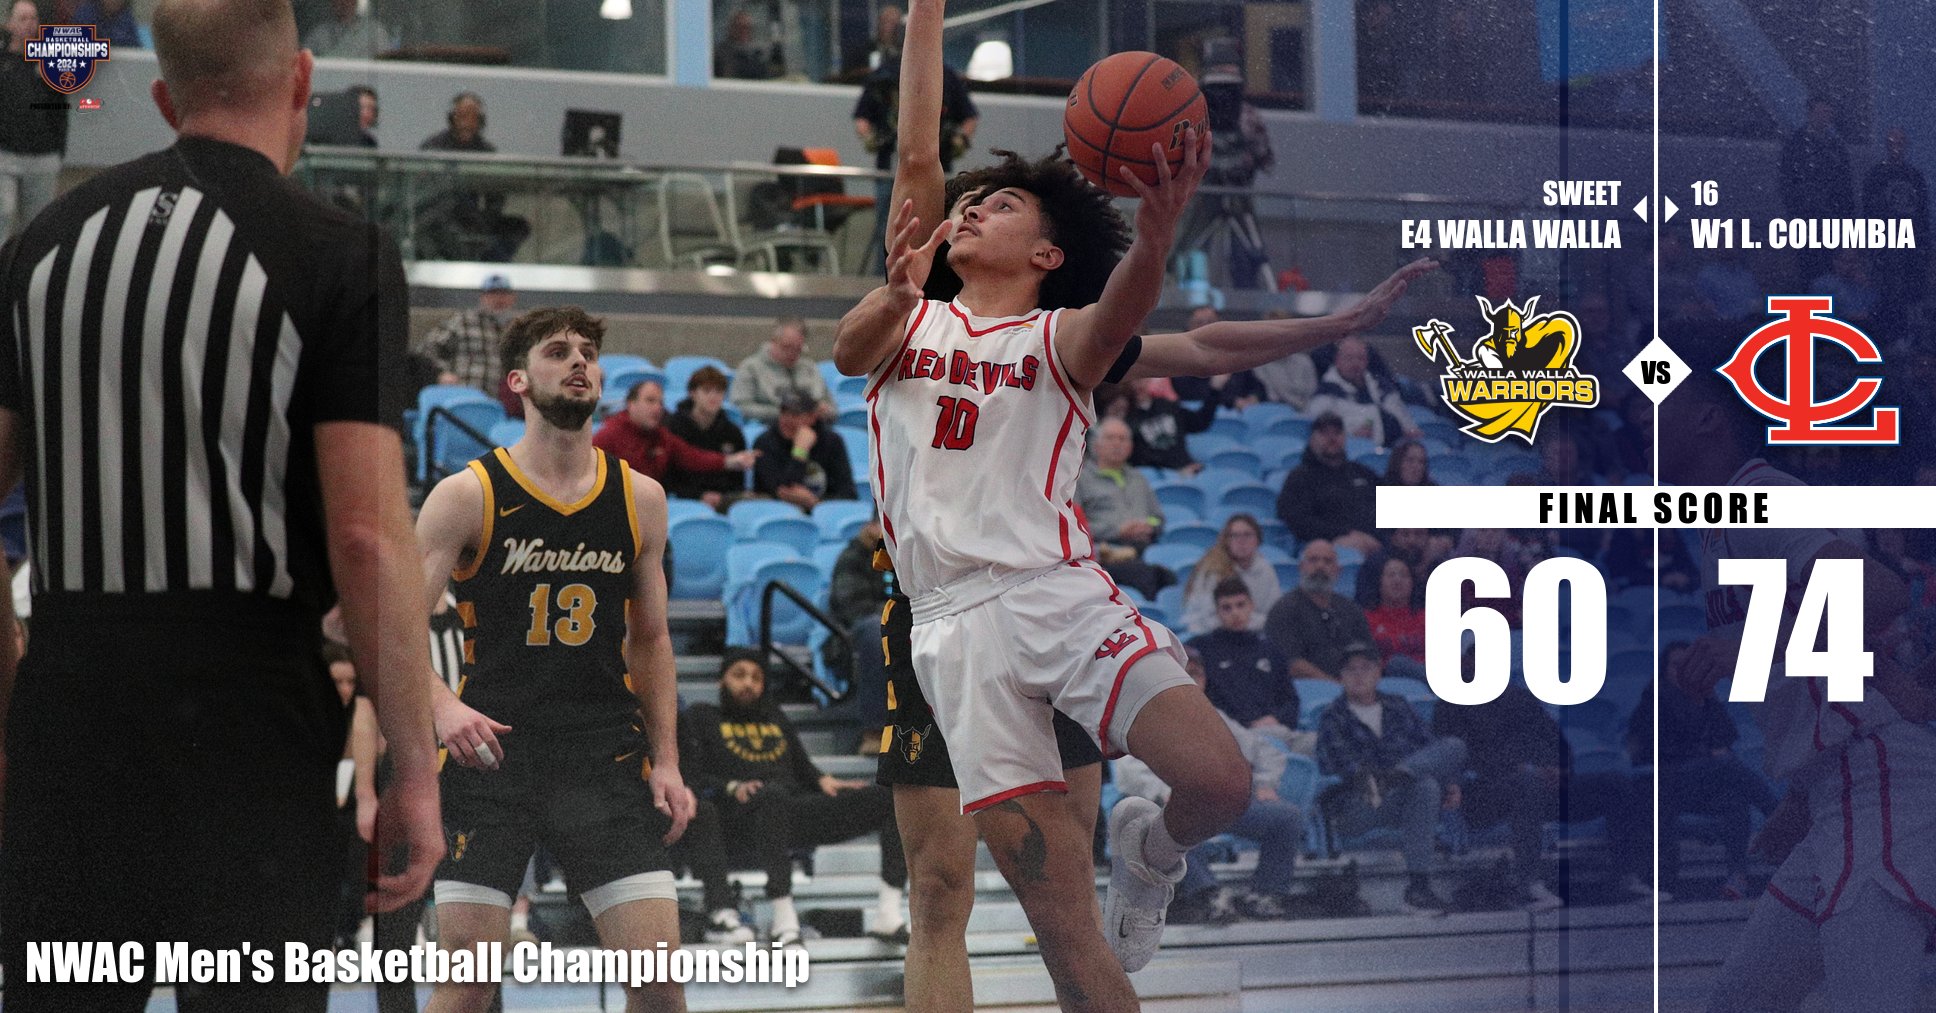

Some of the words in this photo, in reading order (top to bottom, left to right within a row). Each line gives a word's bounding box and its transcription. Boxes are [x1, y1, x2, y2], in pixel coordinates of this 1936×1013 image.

[898, 348, 947, 382] RED
[948, 349, 1040, 396] DEVILS
[931, 395, 980, 451] 10
[500, 537, 626, 576] Warriors
[526, 583, 598, 646] 13
